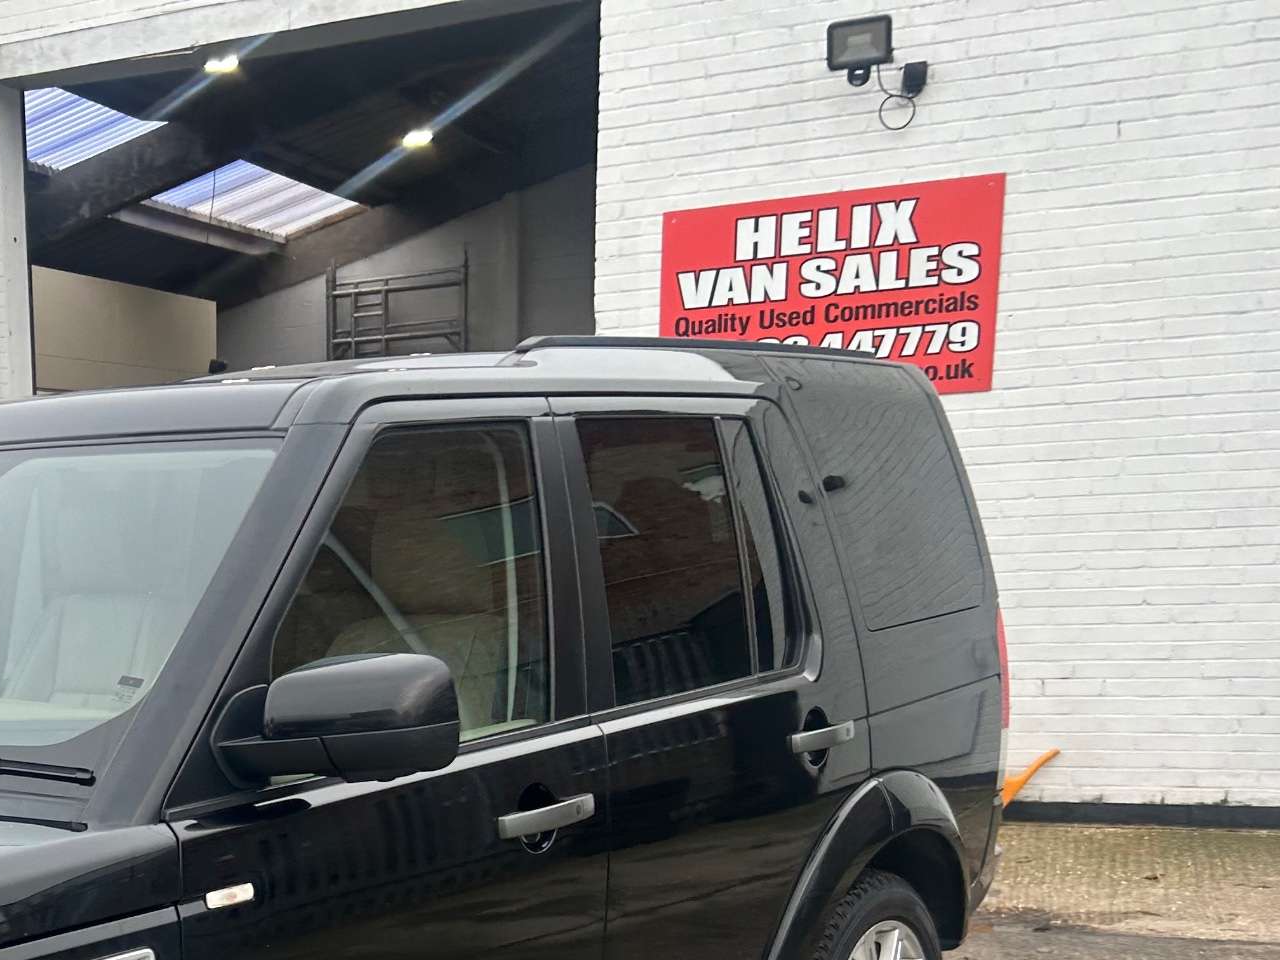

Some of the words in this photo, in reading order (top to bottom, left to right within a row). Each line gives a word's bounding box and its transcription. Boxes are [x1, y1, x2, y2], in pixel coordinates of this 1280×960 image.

[734, 197, 920, 262] HELIX
[676, 261, 789, 311] VAN
[799, 241, 982, 299] SALES
[674, 311, 751, 338] Quality
[759, 304, 815, 330] Used
[824, 291, 979, 323] Commercials
